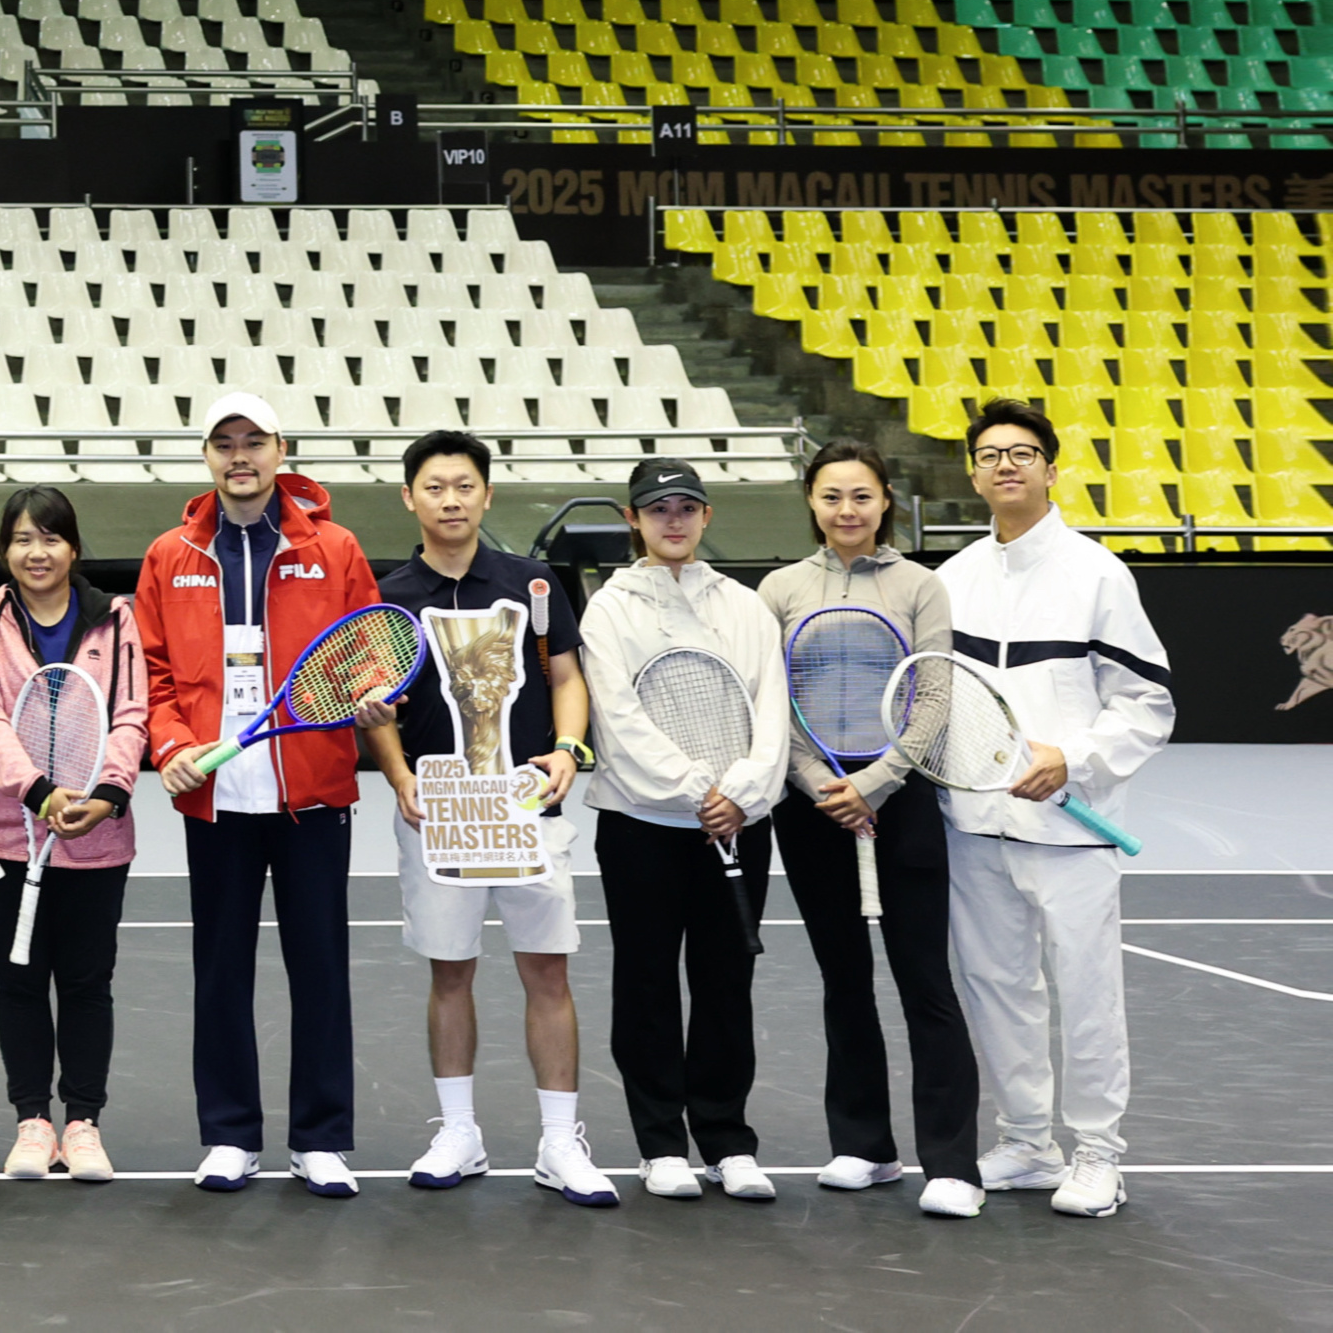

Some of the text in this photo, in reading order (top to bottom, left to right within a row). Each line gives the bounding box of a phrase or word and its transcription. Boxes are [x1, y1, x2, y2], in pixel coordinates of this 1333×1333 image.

[390, 110, 404, 126] B
[659, 121, 693, 139] A11
[443, 148, 485, 165] VIP10
[502, 169, 604, 215] 2025
[617, 171, 724, 216] MGM
[738, 172, 890, 208] MACAU
[905, 172, 1057, 209] TENNIS
[1071, 174, 1271, 210] MASTERS
[278, 562, 326, 581] FILA
[171, 574, 218, 589] CHINA
[421, 759, 465, 780] 2025
[422, 780, 508, 796] MGM MACAU
[423, 796, 509, 823] TENNIS
[425, 823, 538, 851] MASTERS
